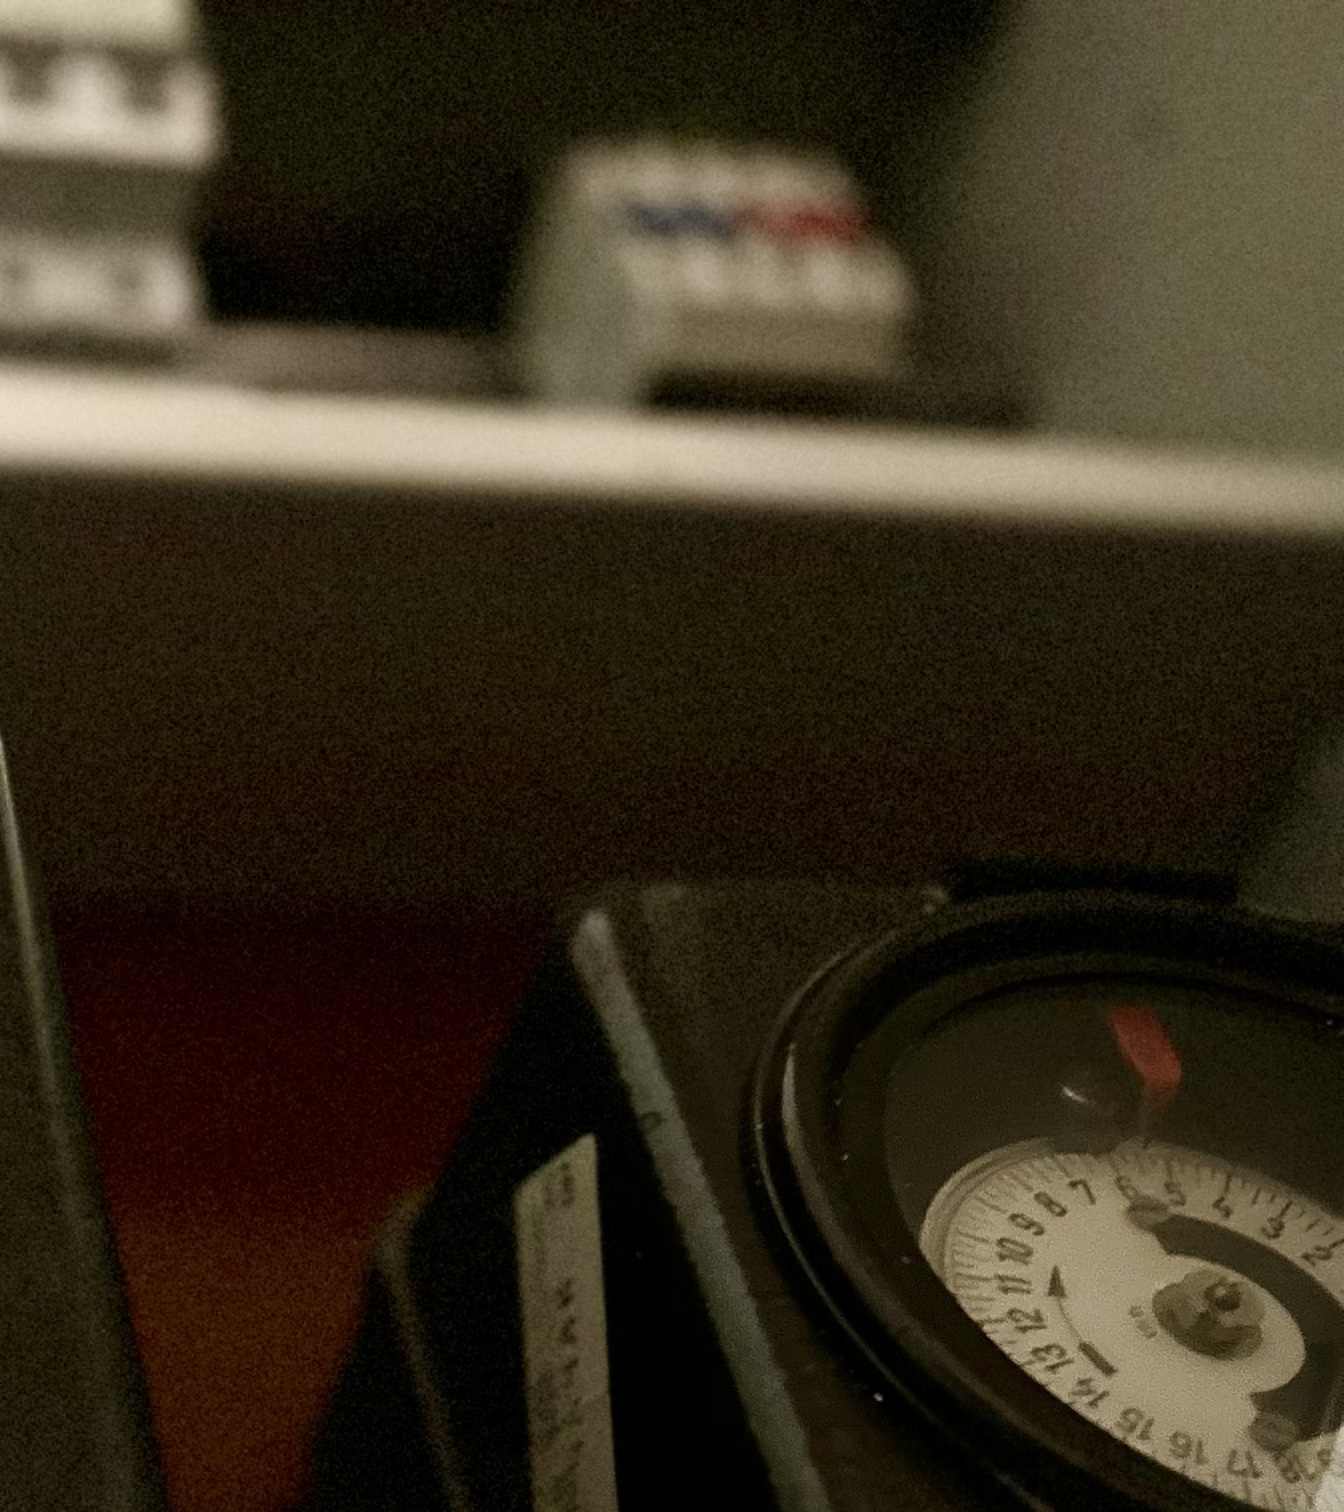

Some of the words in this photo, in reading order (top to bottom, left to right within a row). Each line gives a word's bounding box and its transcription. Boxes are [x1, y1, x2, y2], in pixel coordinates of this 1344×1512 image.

[1033, 1191, 1068, 1217] 8
[1069, 1179, 1096, 1205] 7
[1009, 1213, 1045, 1236] 9
[996, 1237, 1034, 1265] 10
[996, 1273, 1032, 1295] 11
[1007, 1308, 1048, 1333] 12
[1030, 1343, 1075, 1374] 13
[1068, 1378, 1110, 1408] 14
[1115, 1408, 1156, 1442] 15
[1168, 1432, 1210, 1466] 16
[1225, 1448, 1261, 1479] 17
